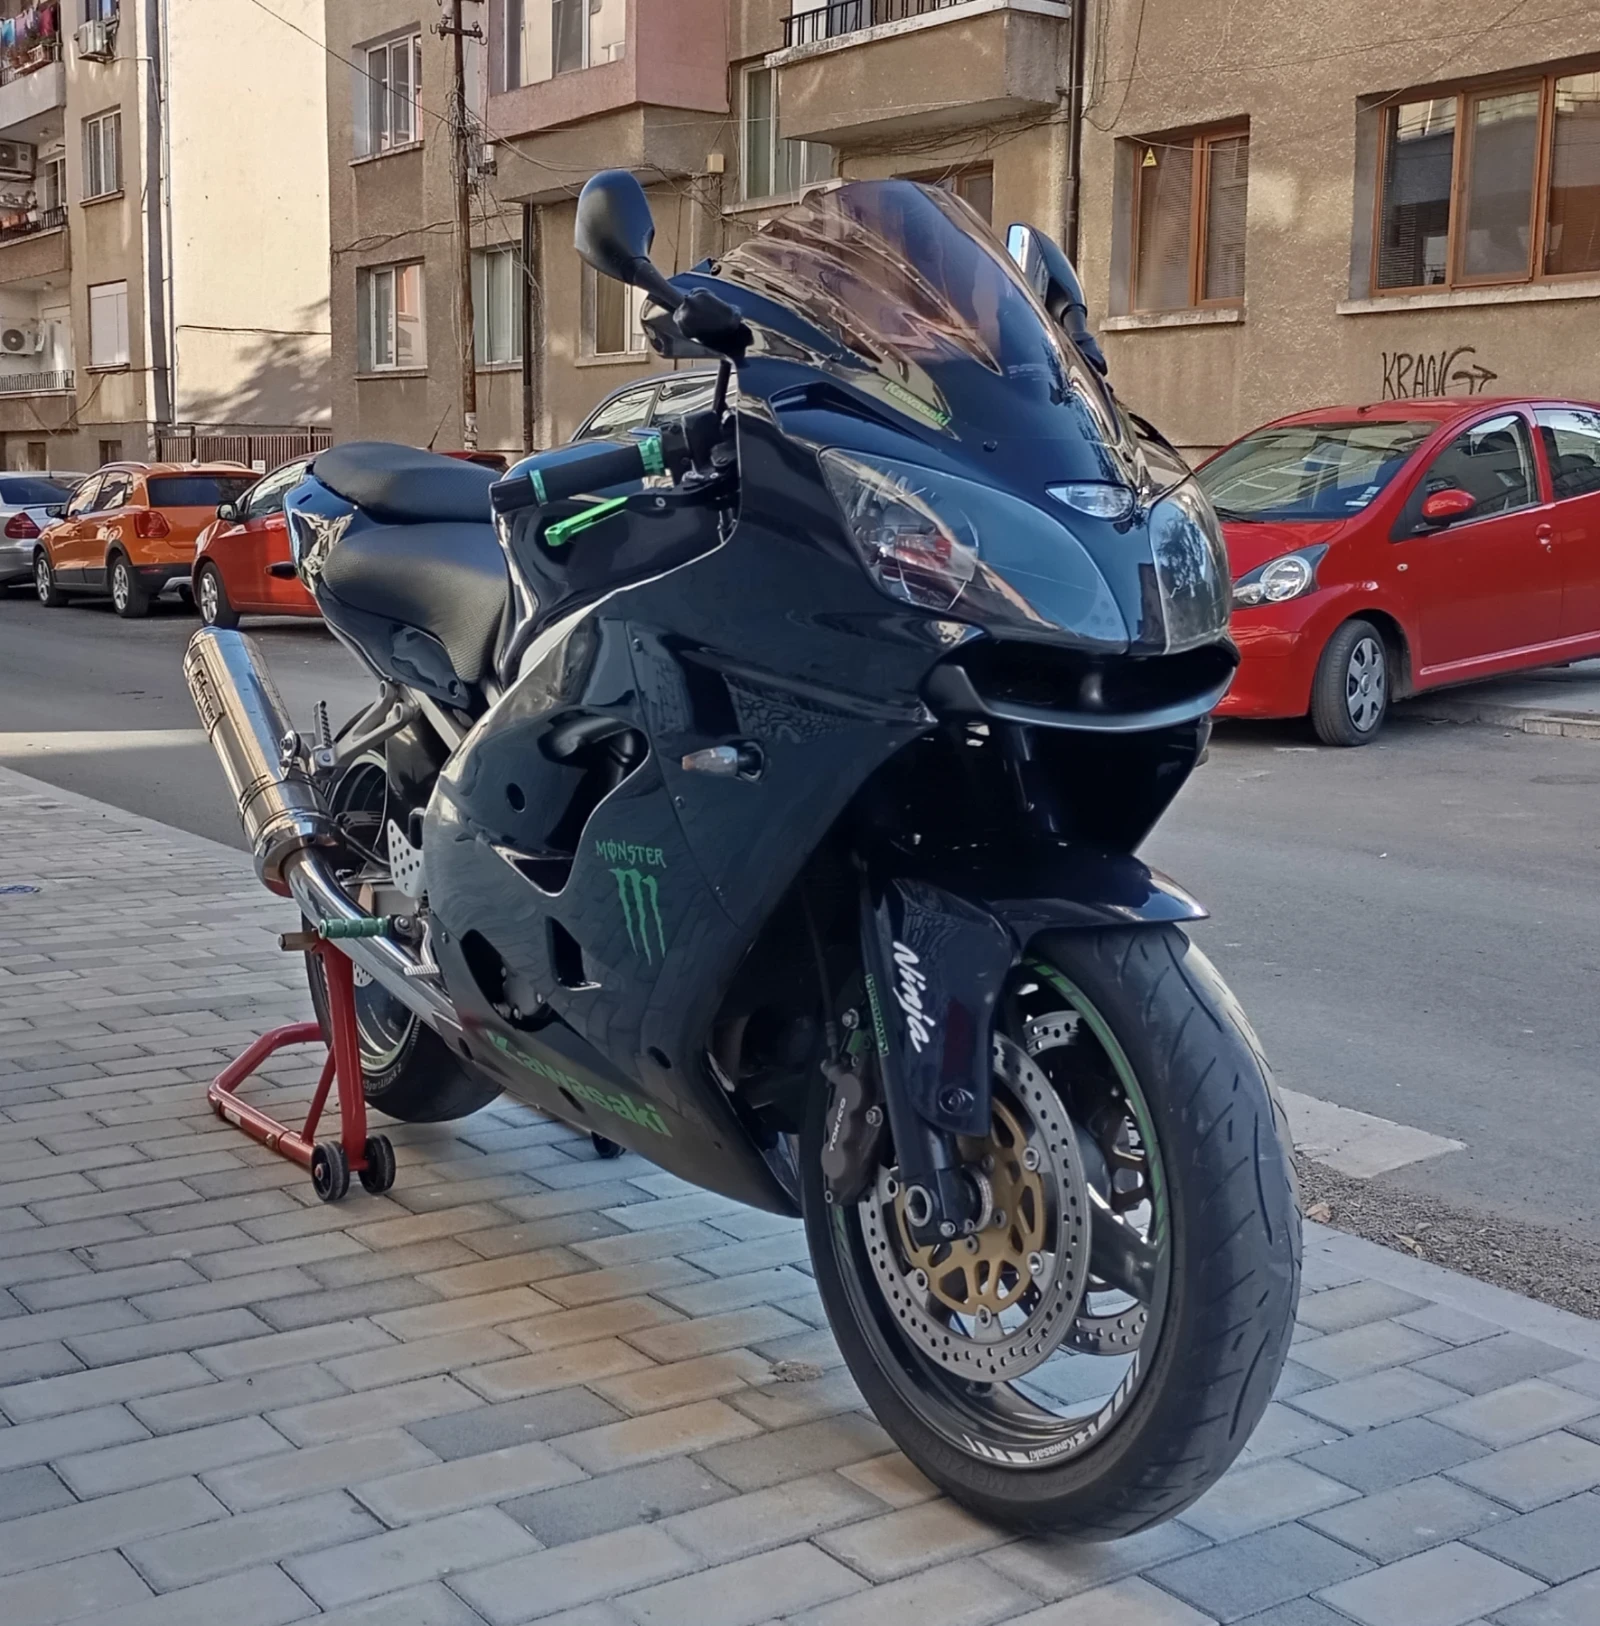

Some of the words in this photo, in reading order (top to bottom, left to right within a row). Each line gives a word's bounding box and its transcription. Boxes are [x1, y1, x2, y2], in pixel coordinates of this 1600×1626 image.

[884, 381, 952, 427] Kawasaki
[892, 941, 936, 1053] Ninja
[486, 1029, 673, 1138] Kawasaki
[829, 1097, 846, 1152] TOKICO
[1028, 1436, 1077, 1462] Kawasaki
